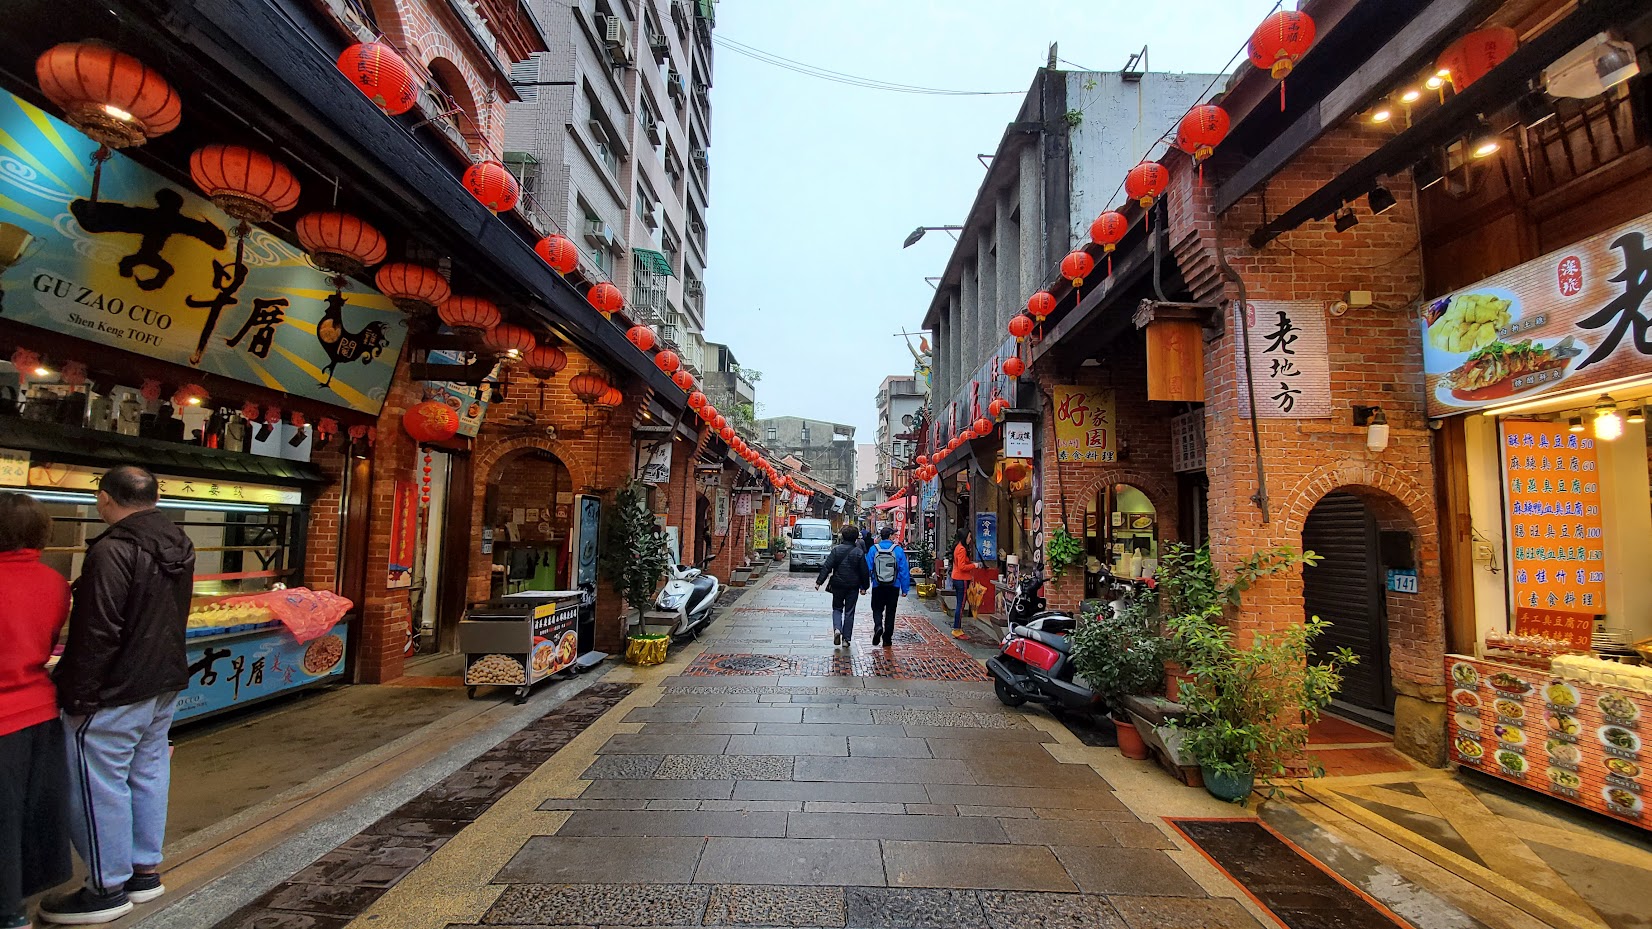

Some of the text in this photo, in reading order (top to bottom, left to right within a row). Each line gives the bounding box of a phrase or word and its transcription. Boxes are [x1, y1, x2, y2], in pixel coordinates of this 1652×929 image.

[68, 188, 290, 365] 古早厝
[33, 273, 172, 330] GU ZAO CUO
[67, 312, 164, 347] Shen Keng TOFU
[1262, 310, 1303, 413] 老地方
[1058, 393, 1108, 450] 好家園
[1507, 434, 1593, 450] 酥炸臭豆腐 50
[1058, 450, 1114, 461] 素食料理
[1509, 455, 1595, 472] 麻辣臭豆腐 60
[1512, 478, 1597, 494] 清蒸臭豆腐 60
[1513, 501, 1598, 516] 麻辣鴨血臭豆腐 90
[1514, 522, 1602, 539] 腸旺臭豆腐 100
[1396, 577, 1414, 591] 141
[1589, 571, 1604, 582] 120
[1520, 612, 1589, 629] 手工臭豆腐 70
[1575, 636, 1588, 645] 30
